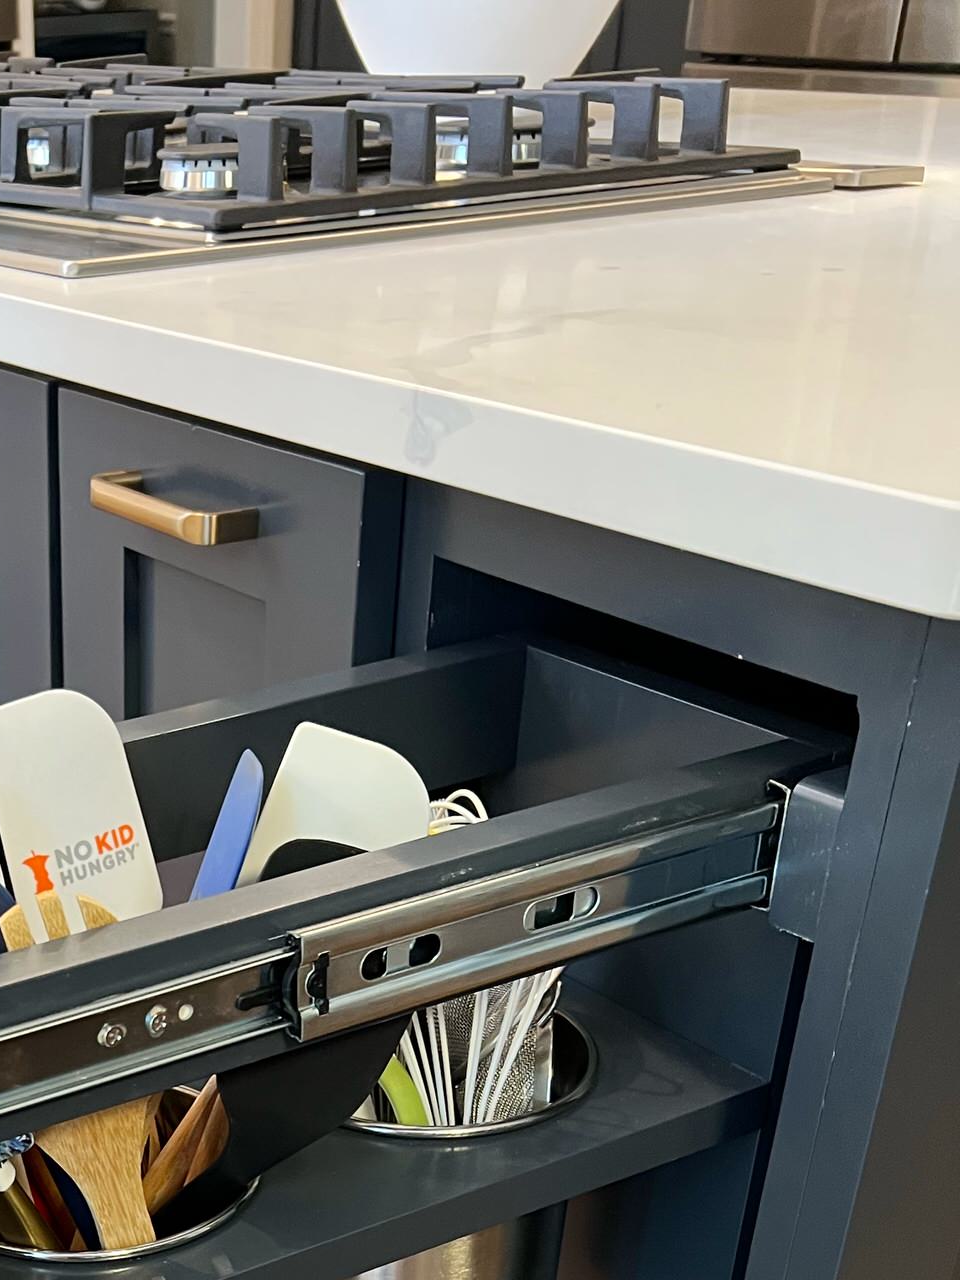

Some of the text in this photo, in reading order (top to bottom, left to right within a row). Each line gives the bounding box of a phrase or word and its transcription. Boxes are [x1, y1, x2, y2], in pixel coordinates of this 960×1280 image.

[54, 824, 134, 869] NO KID
[59, 844, 137, 886] HUNGRY
